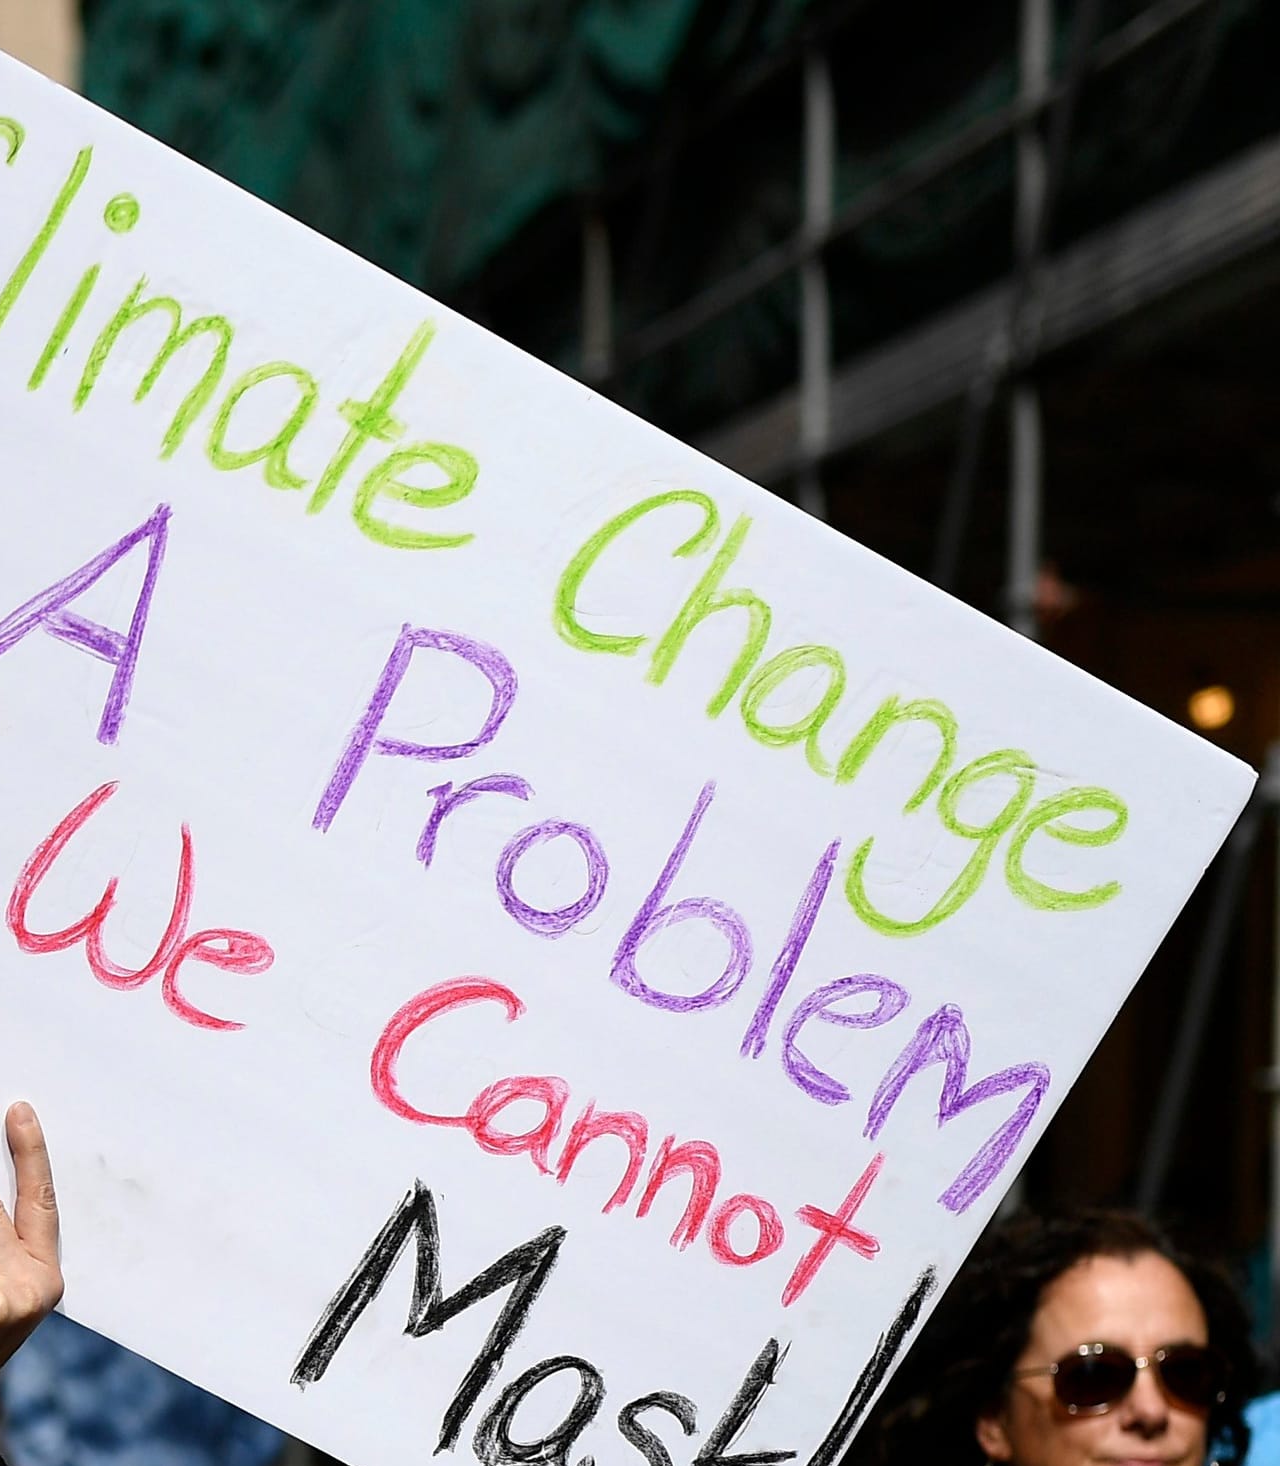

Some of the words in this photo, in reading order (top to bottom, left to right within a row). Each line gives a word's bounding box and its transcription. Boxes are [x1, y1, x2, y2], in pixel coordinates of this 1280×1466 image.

[551, 488, 1130, 939] Change
[6, 783, 275, 1031] We
[369, 976, 883, 1309] Cannot
